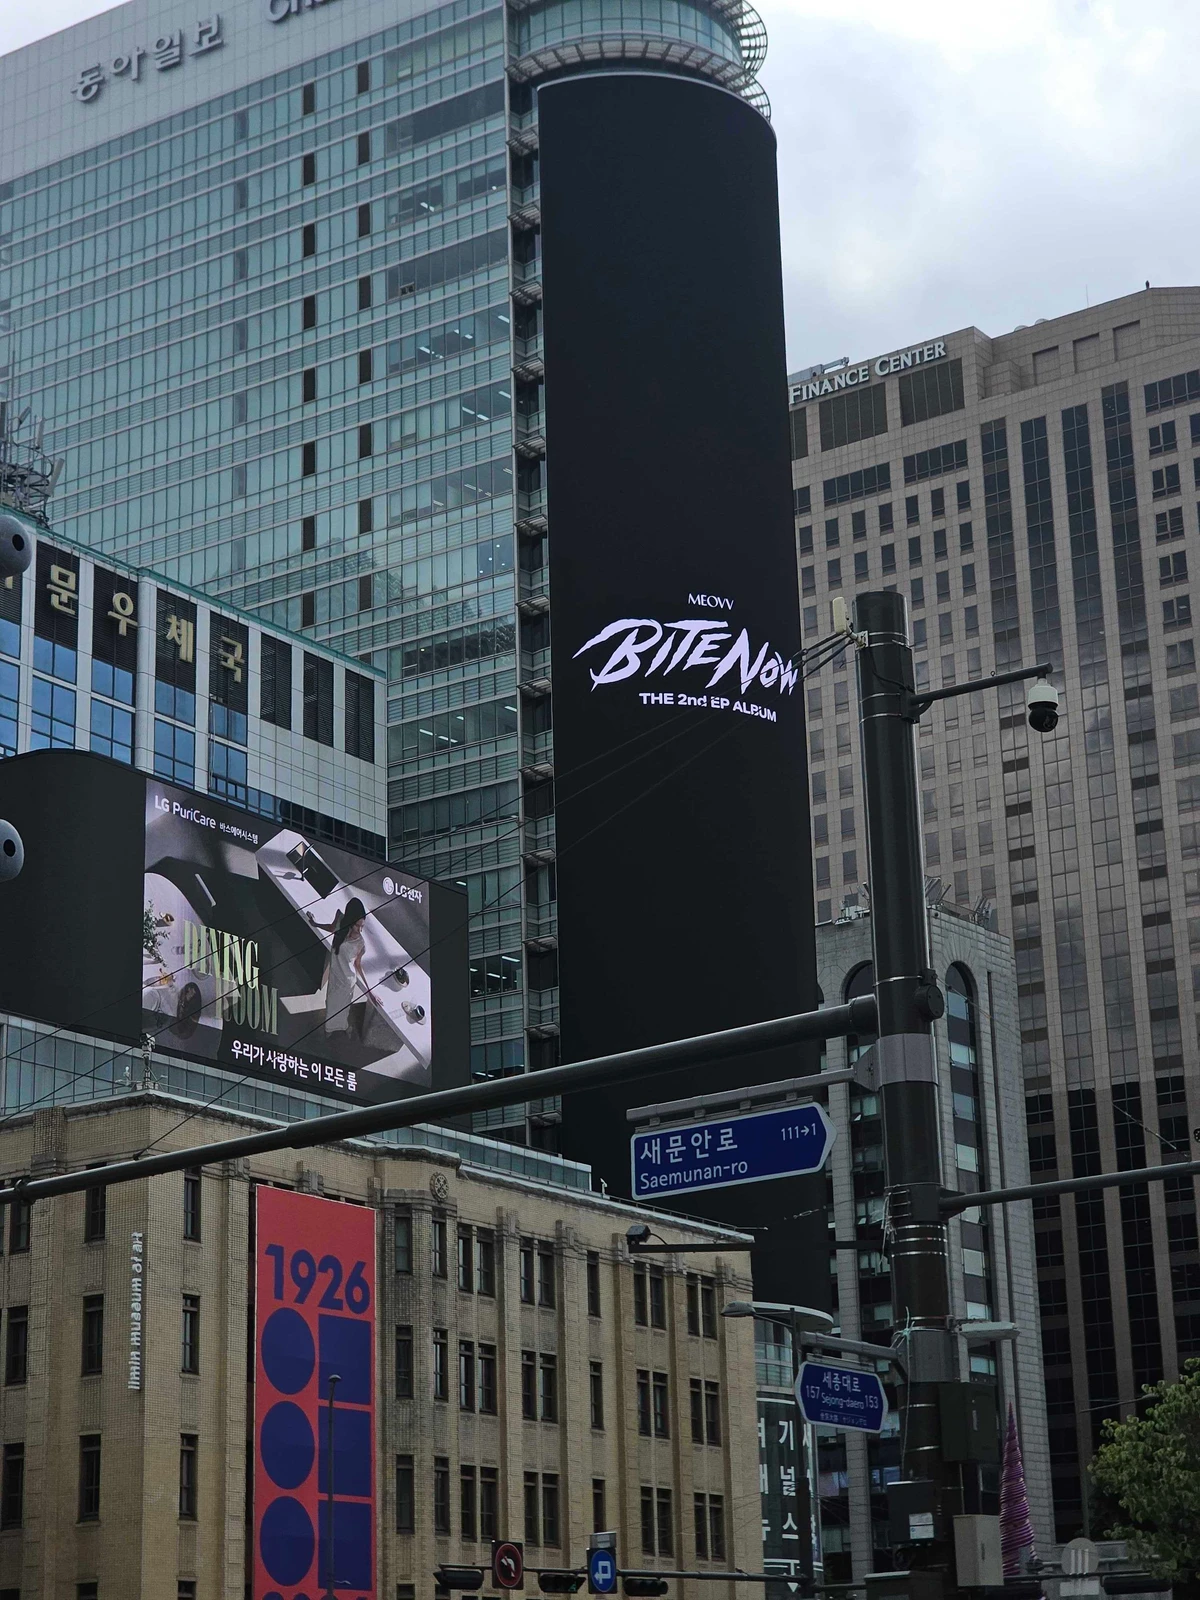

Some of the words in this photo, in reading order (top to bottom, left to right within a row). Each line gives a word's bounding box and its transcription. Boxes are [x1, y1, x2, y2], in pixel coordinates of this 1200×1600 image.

[72, 13, 223, 101] 동아일보
[789, 365, 869, 405] FINANCE
[875, 341, 947, 376] CENTER
[4, 564, 244, 683] 문우체국
[639, 692, 674, 705] THE
[677, 693, 707, 707] 2nd
[711, 696, 730, 709] EP
[733, 701, 777, 722] ALBUM
[155, 795, 170, 812] LG
[172, 801, 216, 829] PuriCare
[183, 920, 260, 990] DINING
[215, 977, 279, 1036] ROOM
[231, 1039, 265, 1066] 우리가
[265, 1050, 310, 1079] 사랑하는
[311, 1063, 322, 1082] 이
[324, 1066, 346, 1088] 모든
[346, 1071, 358, 1092] 룸
[640, 1127, 738, 1165] 새문안로
[640, 1161, 748, 1190] Saemunan-ro
[131, 1231, 144, 1253] art
[131, 1256, 143, 1274] of
[264, 1243, 371, 1315] 1926
[130, 1277, 142, 1346] museum
[806, 1385, 820, 1399] 157
[864, 1394, 879, 1409] 153
[822, 1371, 862, 1393] 세종대로
